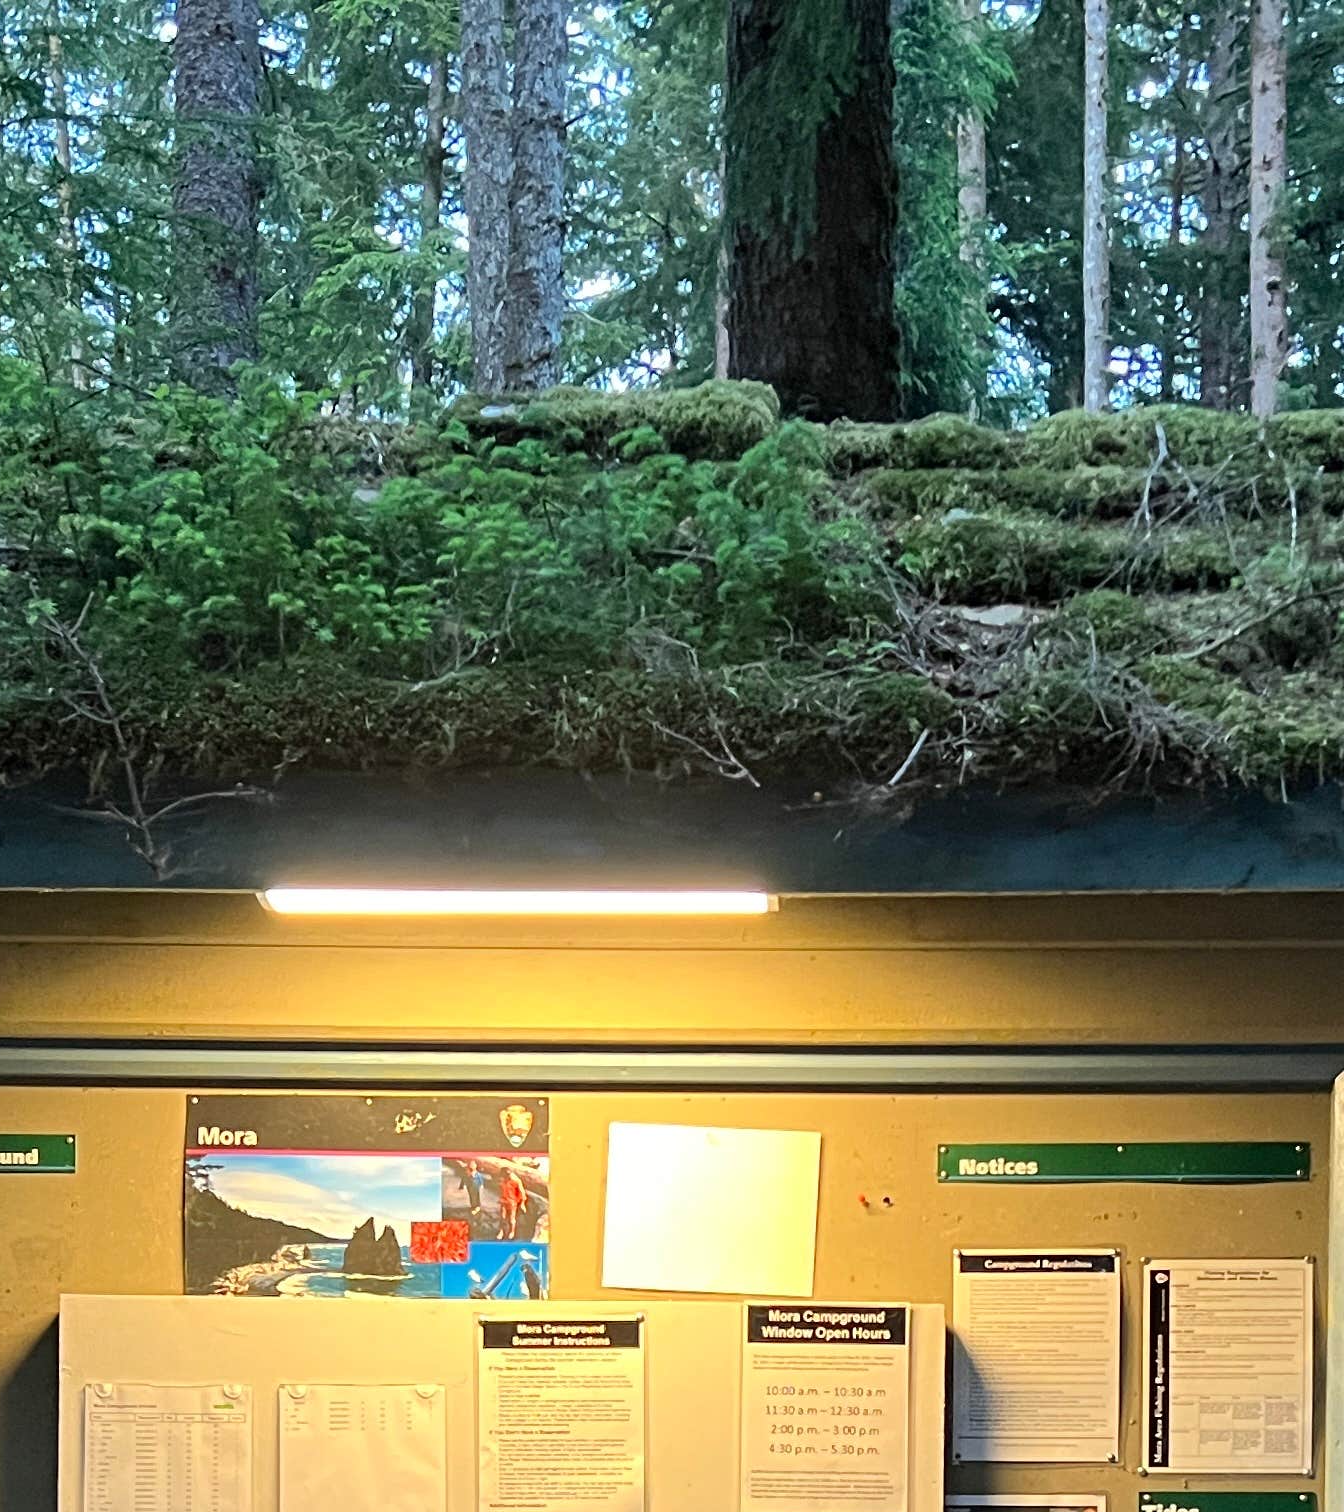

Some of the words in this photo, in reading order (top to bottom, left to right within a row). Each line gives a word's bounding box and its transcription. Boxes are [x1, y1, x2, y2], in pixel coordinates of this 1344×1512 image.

[197, 1126, 258, 1146] Mora
[959, 1158, 1038, 1175] Notices
[984, 1259, 1041, 1271] Campground
[768, 1310, 801, 1322] Mora
[803, 1310, 886, 1325] Campground
[516, 1324, 542, 1334] Mora
[542, 1324, 605, 1335] Campground
[761, 1326, 814, 1339] Window
[815, 1327, 850, 1341] Open
[852, 1327, 892, 1340] Hours
[512, 1336, 552, 1346] Summer
[553, 1336, 611, 1346] Instructions
[766, 1386, 796, 1396] 10:00
[834, 1387, 864, 1397] 10:30
[1154, 1385, 1166, 1418] Fishing
[765, 1405, 795, 1415] 11:30
[830, 1406, 860, 1416] 12:30
[771, 1424, 794, 1434] 2:00
[833, 1425, 856, 1435] 3:00
[1154, 1418, 1163, 1438] Area
[769, 1443, 792, 1454] 4:30
[830, 1444, 855, 1455] 5:30
[1153, 1440, 1162, 1463] Mora
